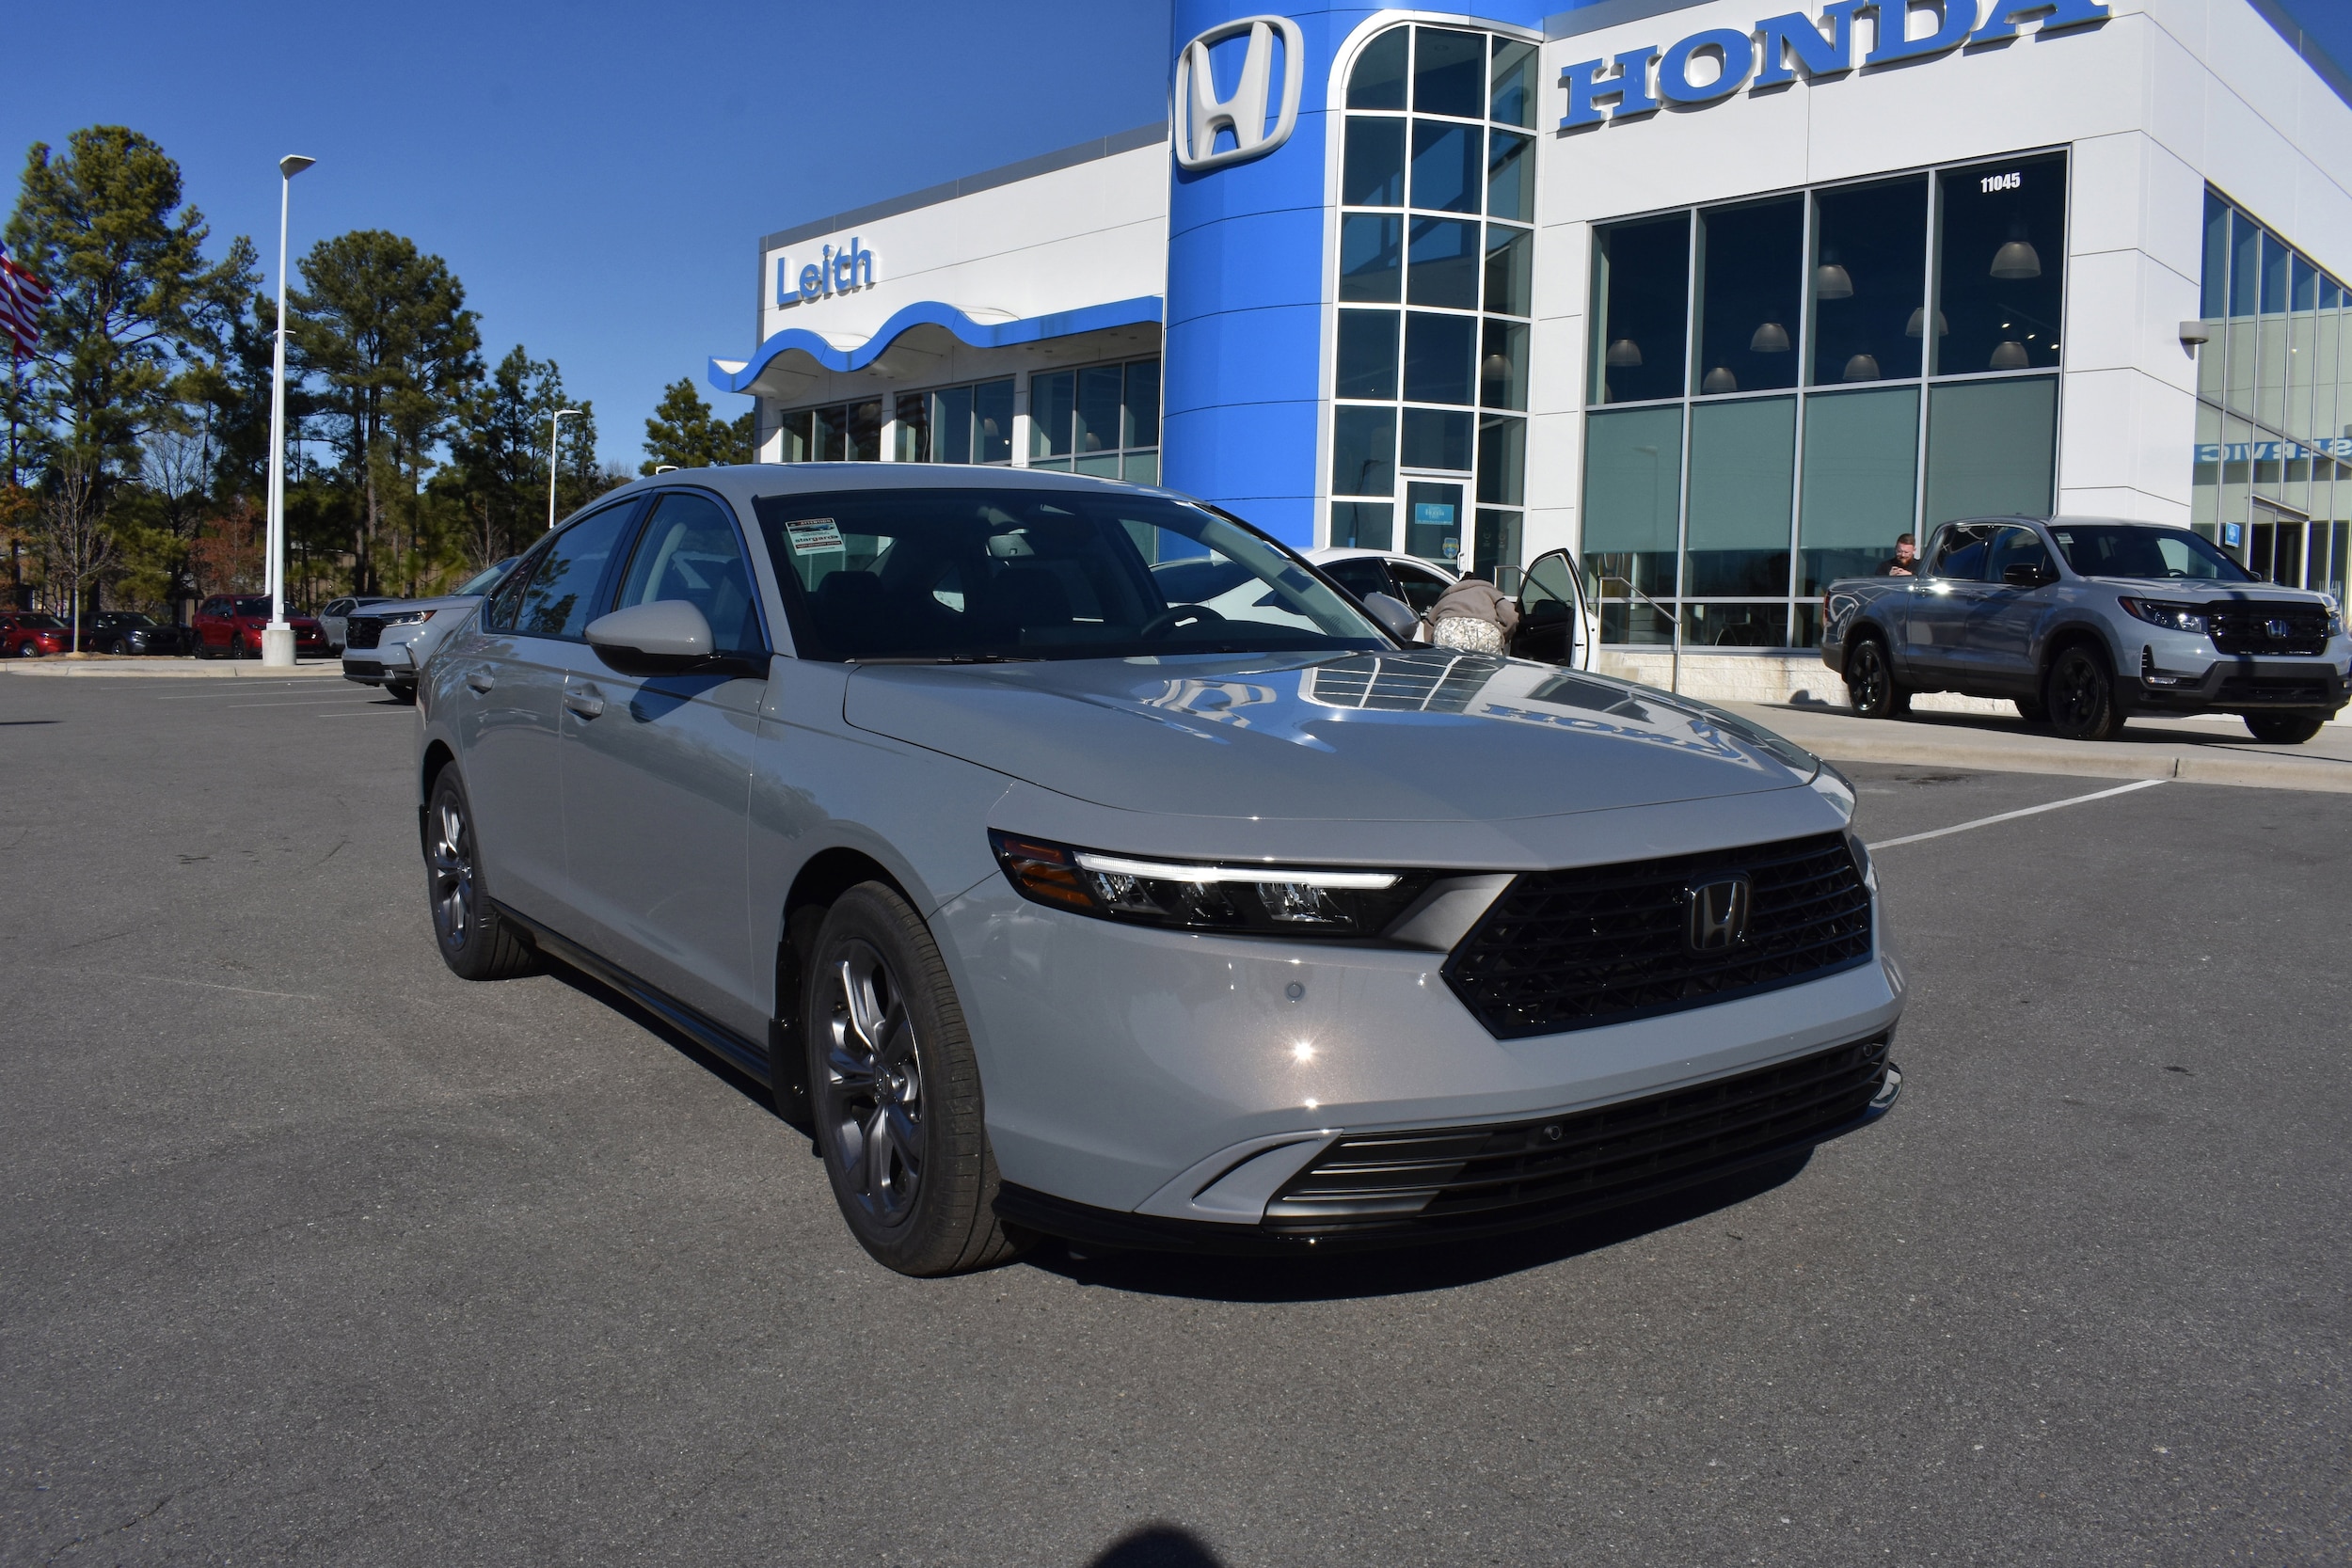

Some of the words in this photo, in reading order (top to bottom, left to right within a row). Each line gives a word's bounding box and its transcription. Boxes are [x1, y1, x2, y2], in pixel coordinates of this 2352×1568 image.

[1560, 0, 2109, 129] HONDA
[1980, 172, 2021, 193] 11045
[777, 236, 873, 306] Leith
